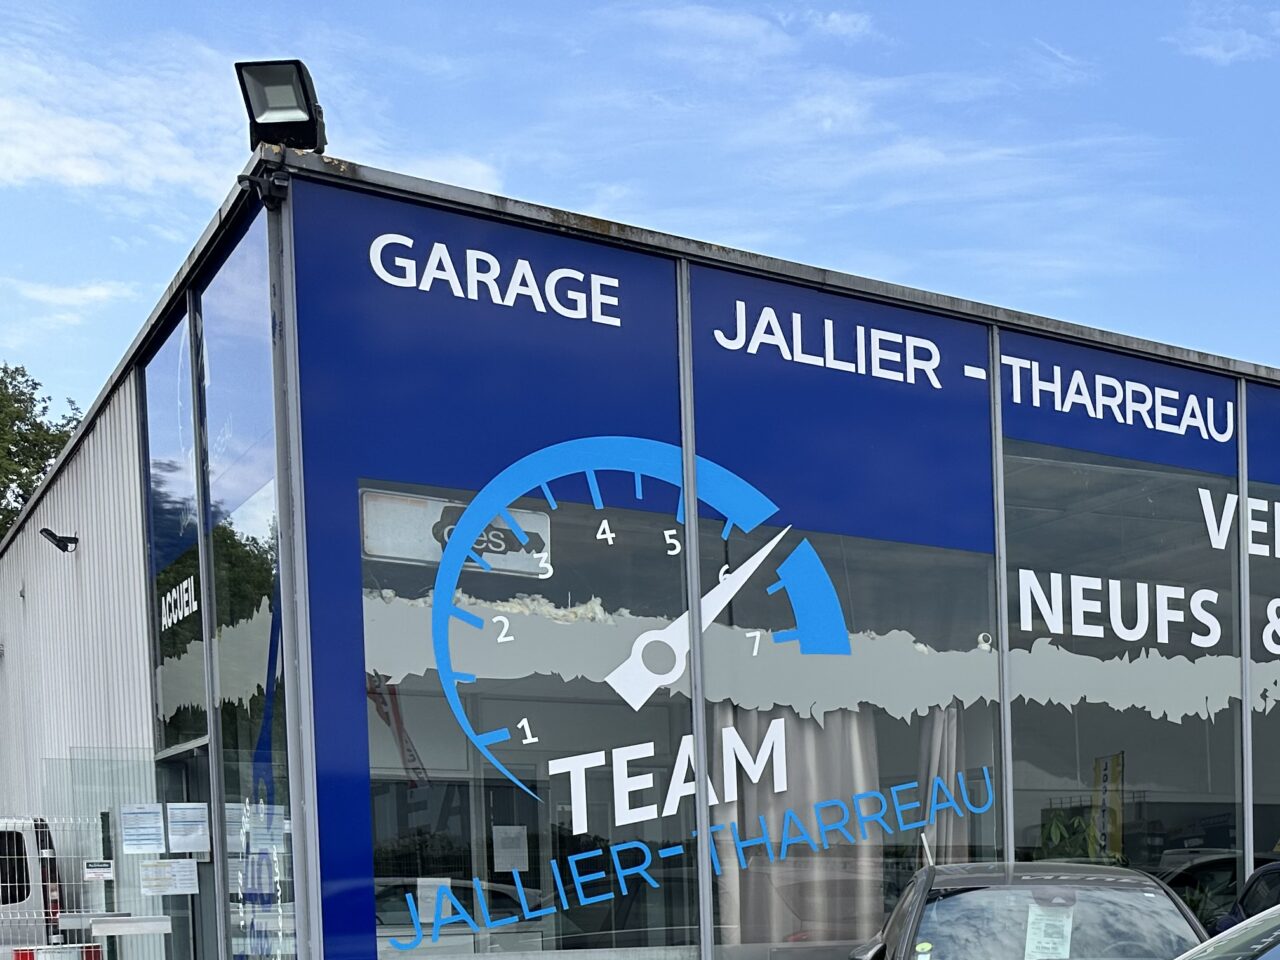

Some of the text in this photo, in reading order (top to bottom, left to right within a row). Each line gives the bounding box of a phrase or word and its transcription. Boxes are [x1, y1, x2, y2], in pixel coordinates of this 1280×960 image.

[369, 232, 621, 327] GARAGE
[713, 300, 942, 390] JALLIER
[1001, 354, 1234, 443] THARREAU
[595, 519, 616, 547] 4
[663, 528, 682, 556] 5
[533, 552, 554, 579] 3
[161, 575, 198, 632] ACCUEIL
[1018, 568, 1222, 648] NEUFS
[491, 615, 515, 643] 2
[745, 631, 762, 656] 7
[516, 717, 539, 745] 1
[548, 717, 788, 836] TEAM
